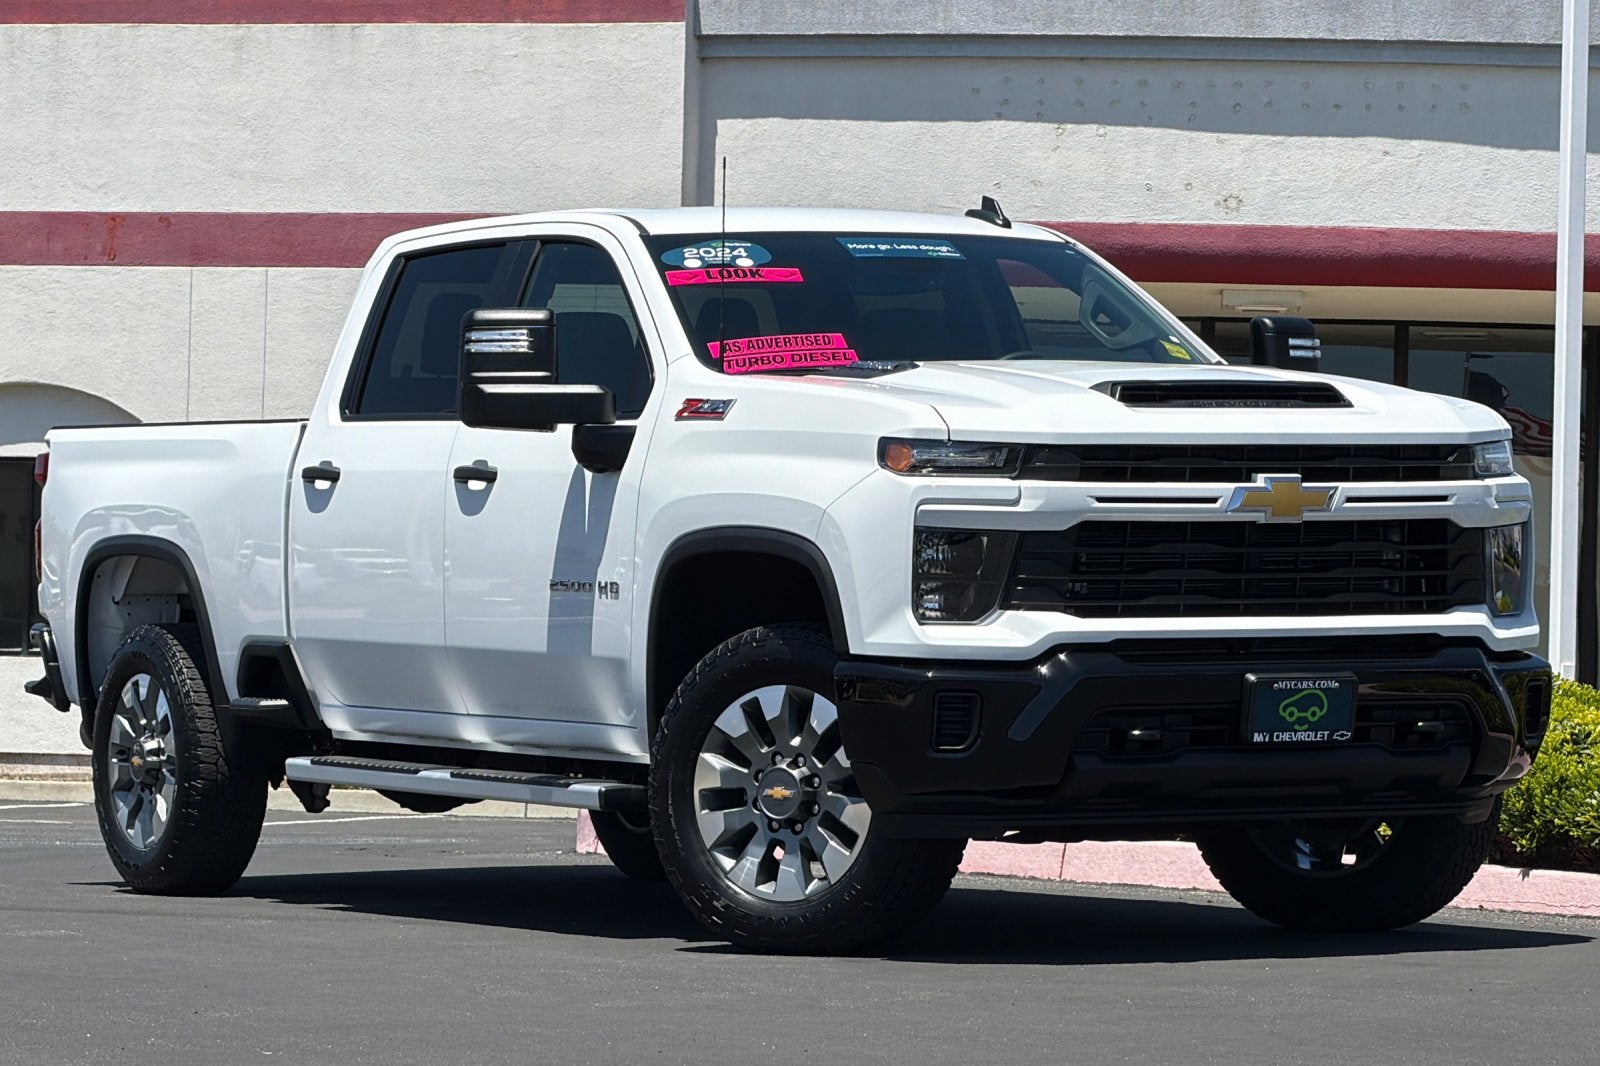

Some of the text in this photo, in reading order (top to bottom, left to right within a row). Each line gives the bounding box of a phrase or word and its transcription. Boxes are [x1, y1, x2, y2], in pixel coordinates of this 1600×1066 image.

[683, 247, 748, 258] 2024
[704, 269, 766, 280] LOOK
[723, 335, 834, 354] AS ADVERTISED
[724, 351, 853, 369] TURBO DIESEL
[549, 579, 593, 592] 2500
[1278, 680, 1336, 689] MYCARS.COM
[1253, 731, 1330, 742] MY CHEVROLET
